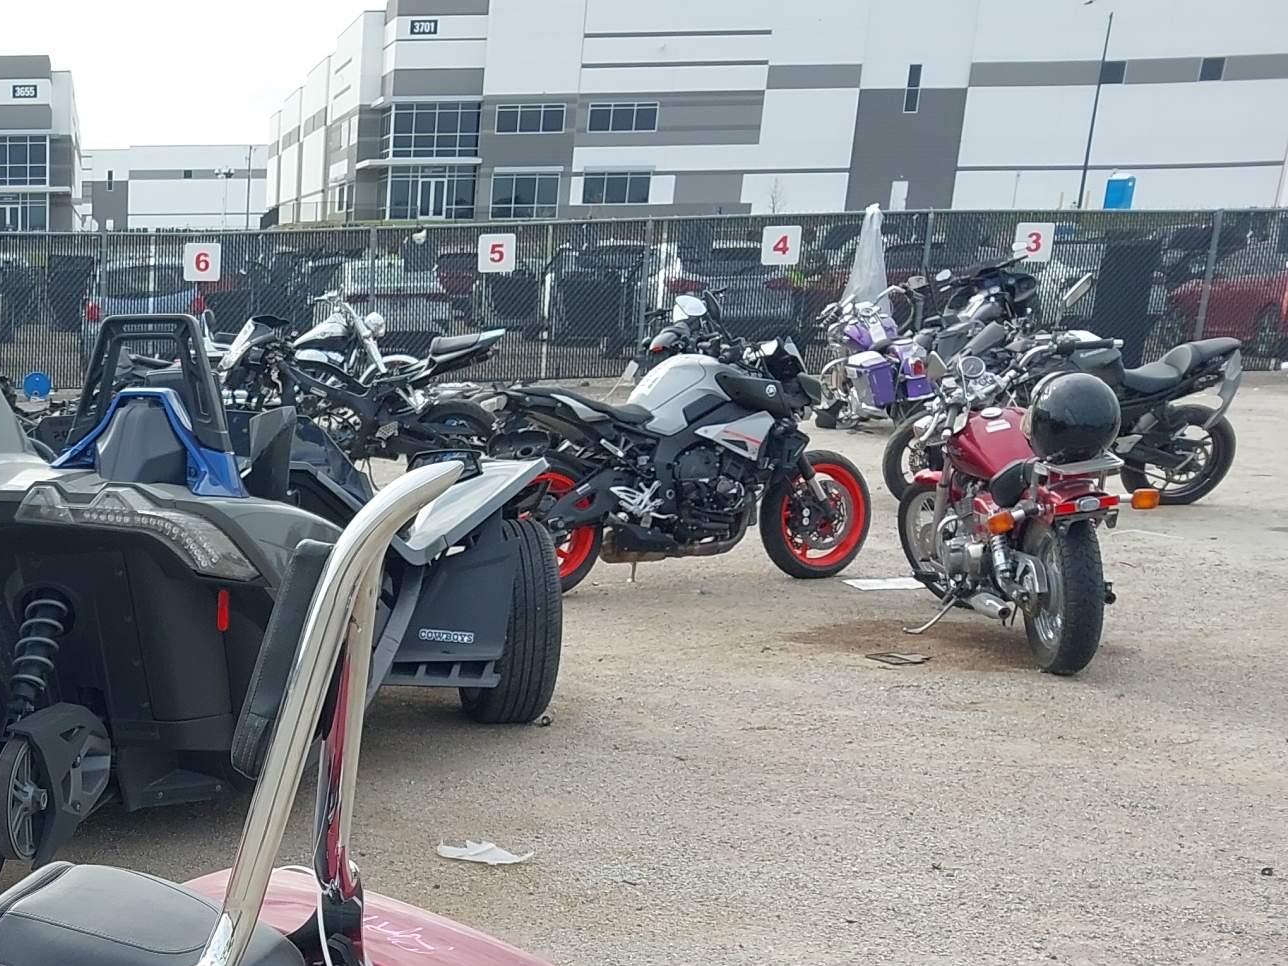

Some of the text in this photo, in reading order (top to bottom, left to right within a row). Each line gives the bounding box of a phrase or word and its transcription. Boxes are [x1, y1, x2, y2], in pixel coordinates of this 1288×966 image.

[413, 21, 435, 33] 3701
[14, 86, 35, 97] 3655
[772, 235, 790, 255] 4
[1025, 232, 1041, 252] 3
[195, 252, 210, 273] 6
[490, 243, 505, 263] 5
[418, 629, 474, 643] COWBOYS
